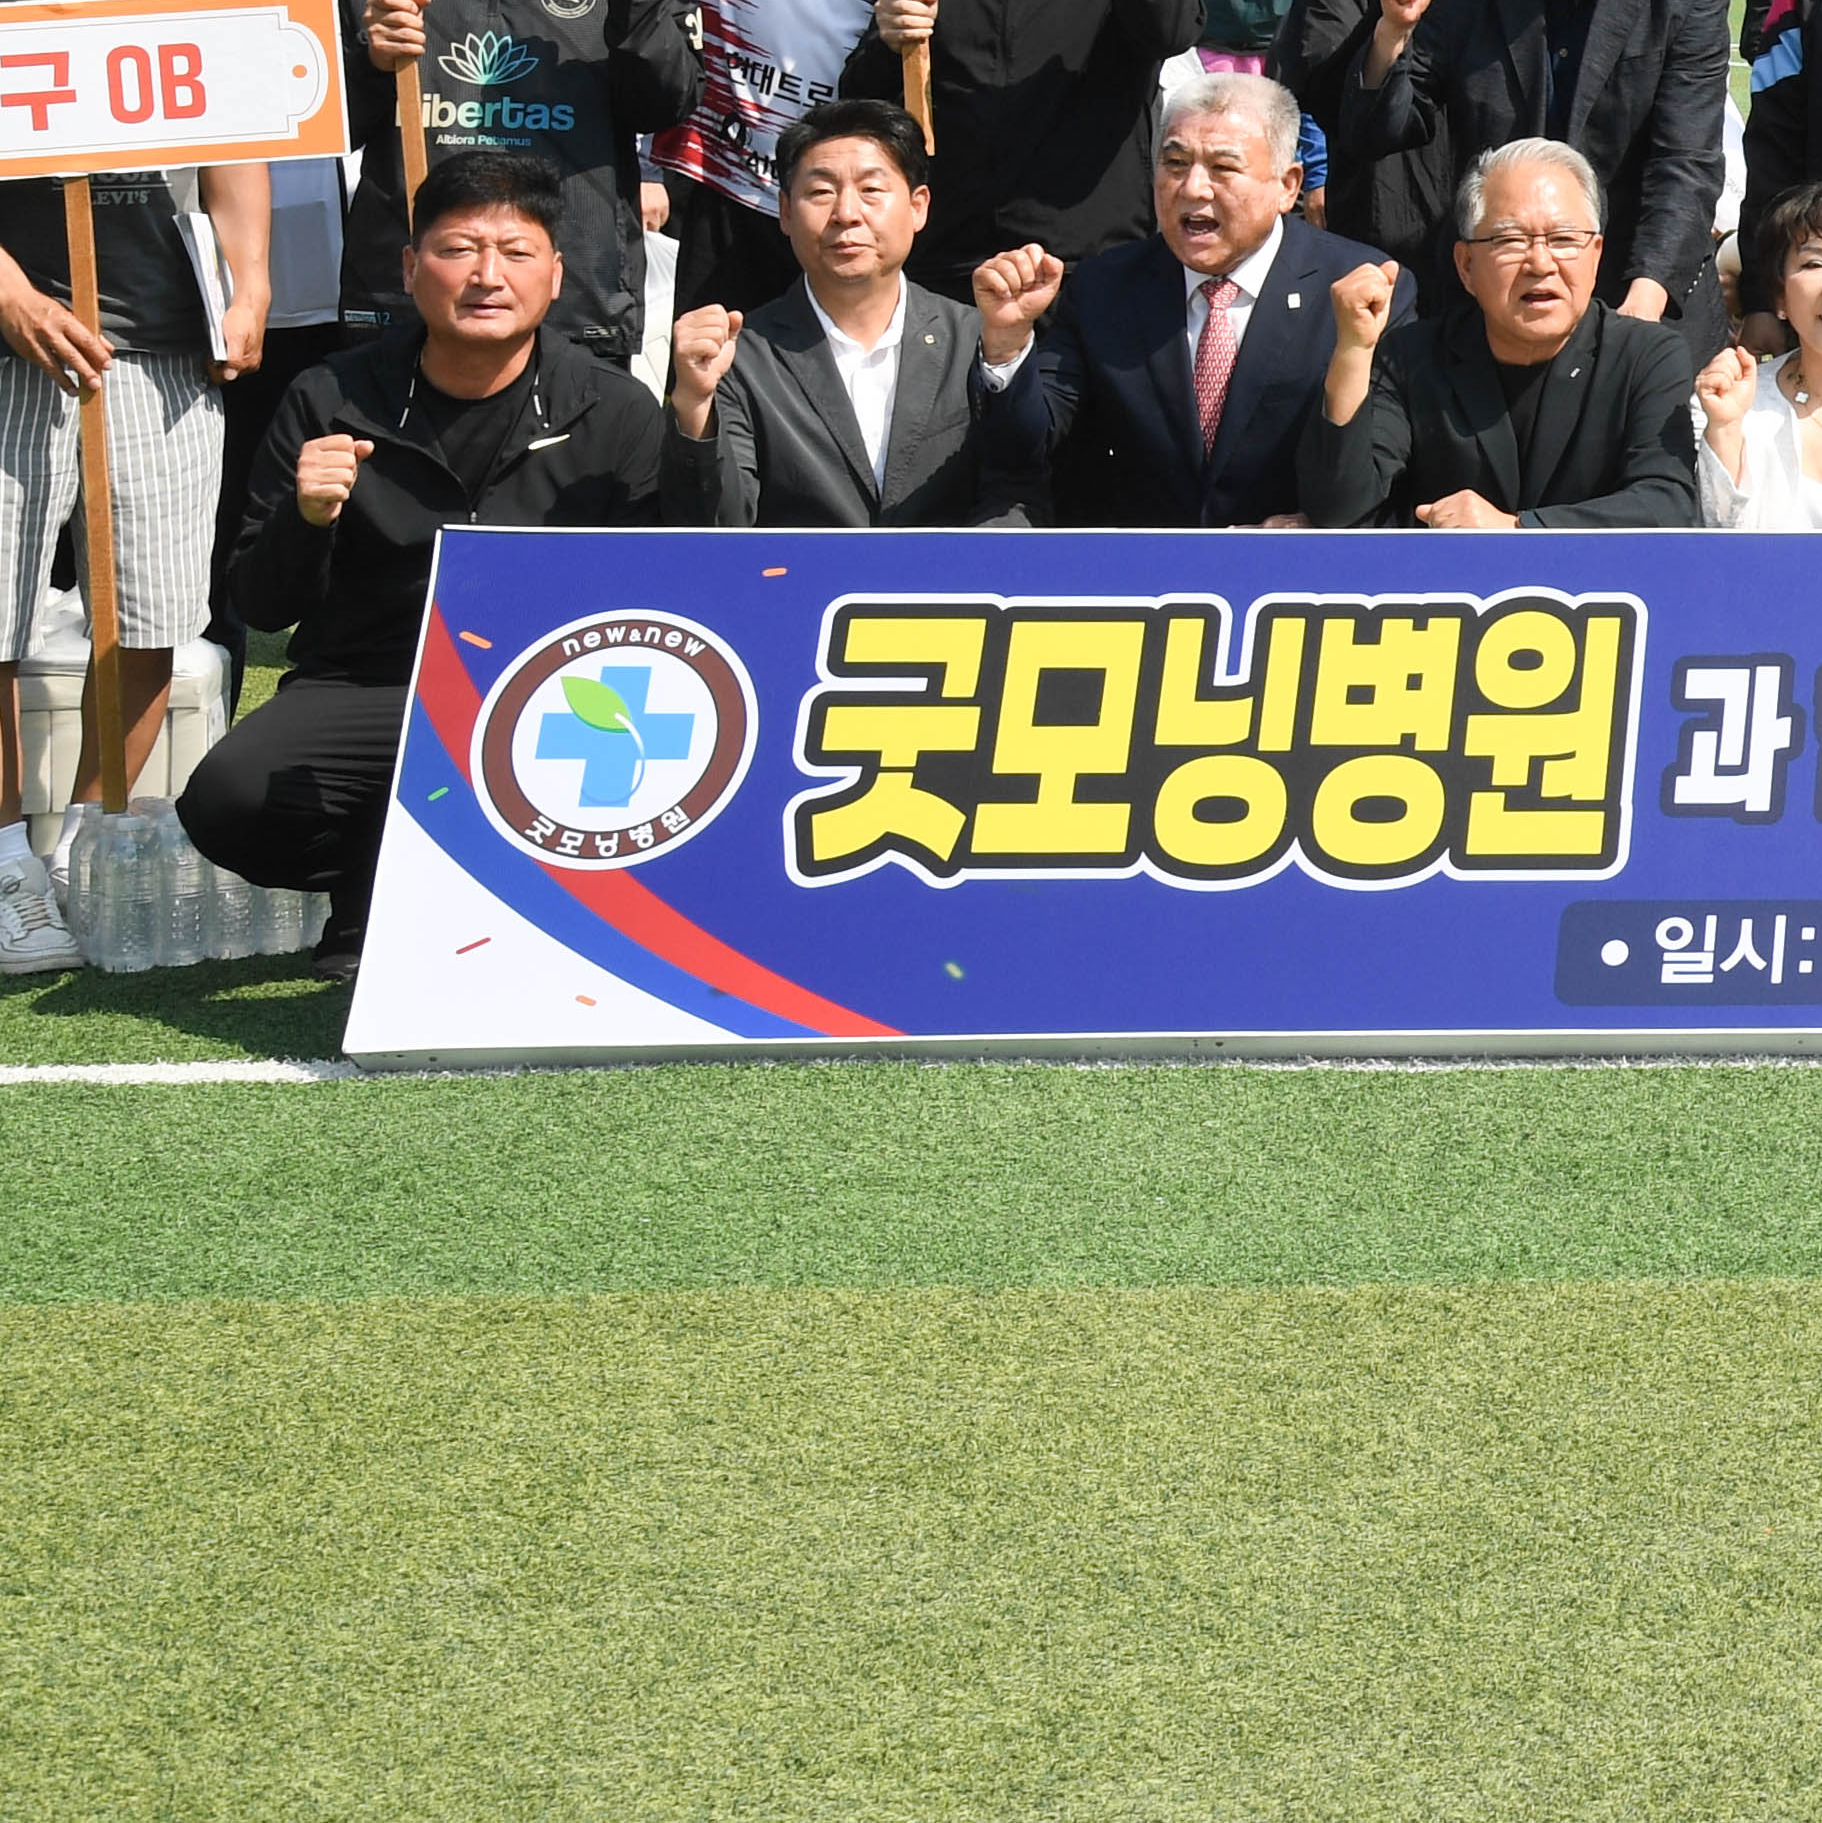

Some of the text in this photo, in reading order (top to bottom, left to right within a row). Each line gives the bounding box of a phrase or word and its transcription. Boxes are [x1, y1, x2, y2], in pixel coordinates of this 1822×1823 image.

[108, 44, 205, 122] OB
[395, 93, 575, 130] ibertas
[562, 626, 706, 656] new&new
[813, 612, 1620, 864] 굿모닝병원
[1675, 667, 1791, 811] 과
[524, 805, 691, 858] 굿모닝병원
[1656, 915, 1814, 983] 일시:
